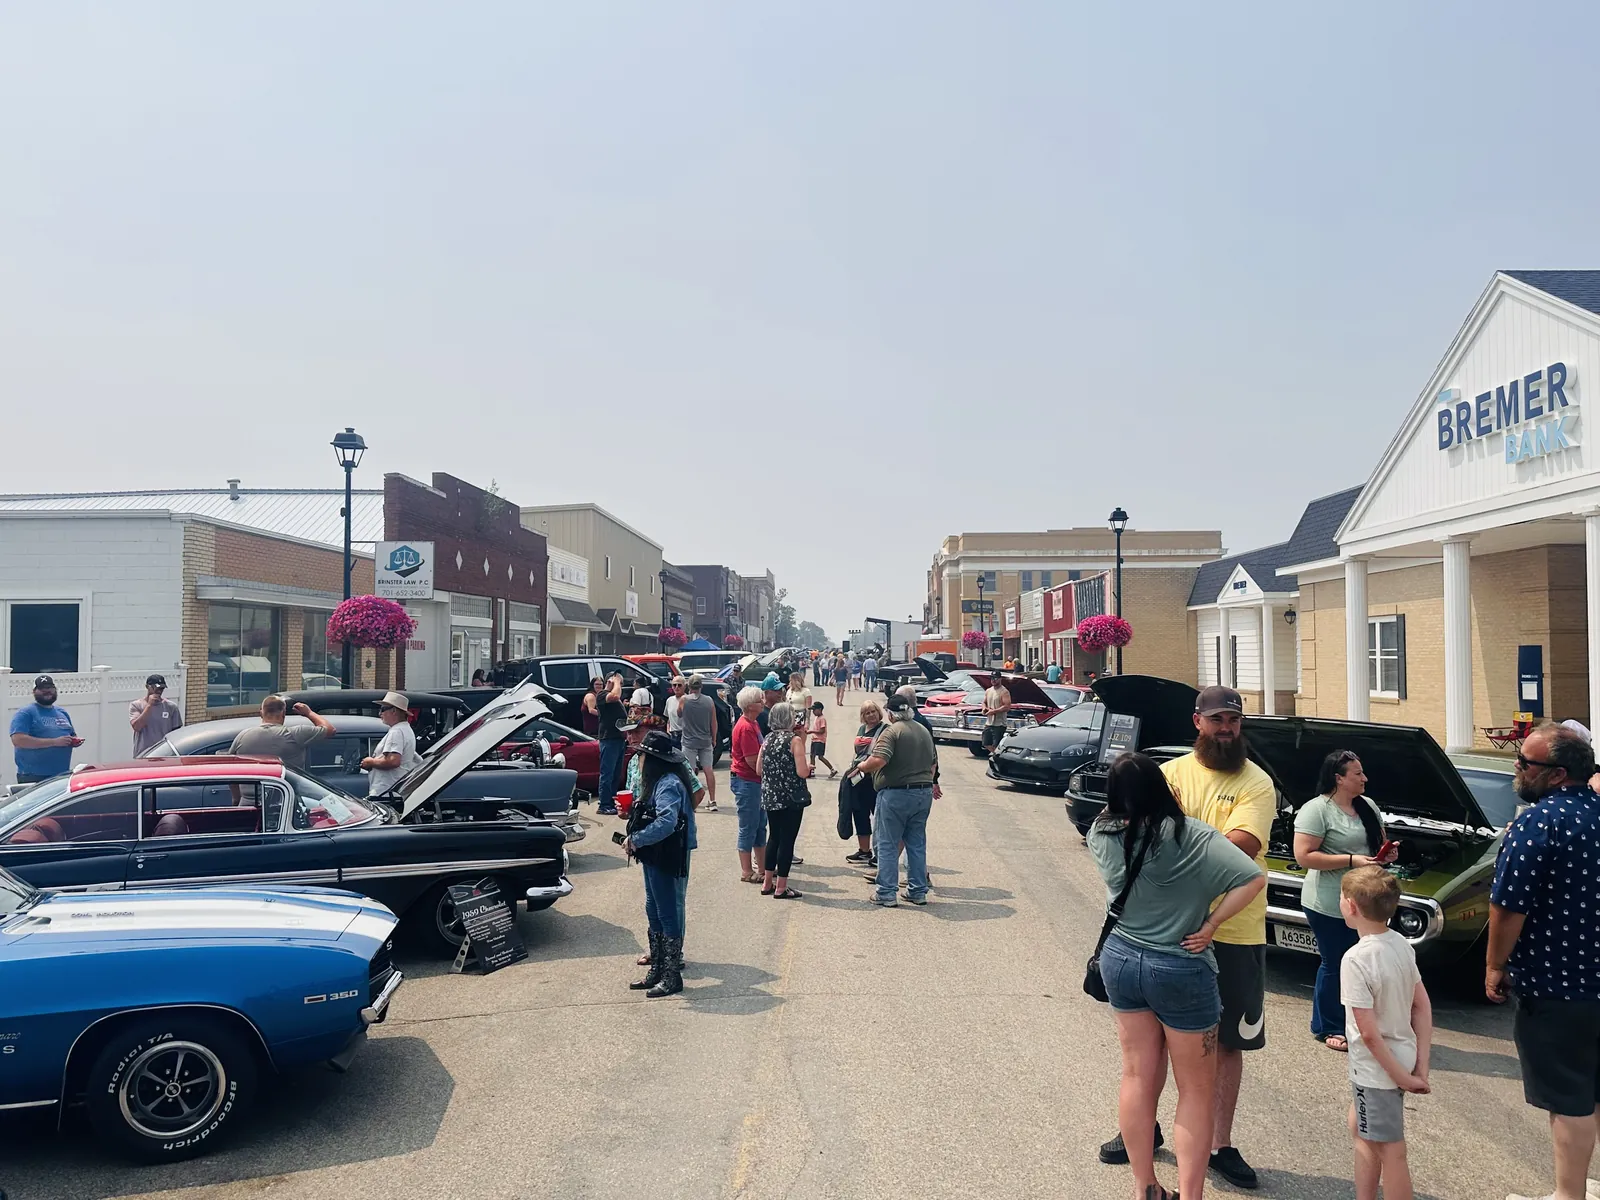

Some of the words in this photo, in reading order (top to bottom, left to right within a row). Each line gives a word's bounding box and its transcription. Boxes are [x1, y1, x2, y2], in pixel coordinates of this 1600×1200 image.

[1438, 362, 1569, 451] BREMER
[1505, 416, 1570, 465] BANK
[462, 908, 480, 920] 1959
[1282, 930, 1318, 947] A63586
[329, 990, 359, 1001] 350
[107, 1044, 143, 1094] Radial
[147, 1032, 174, 1044] T/A
[163, 1080, 237, 1150] BFGoodrich
[1358, 1098, 1368, 1133] Hurley
